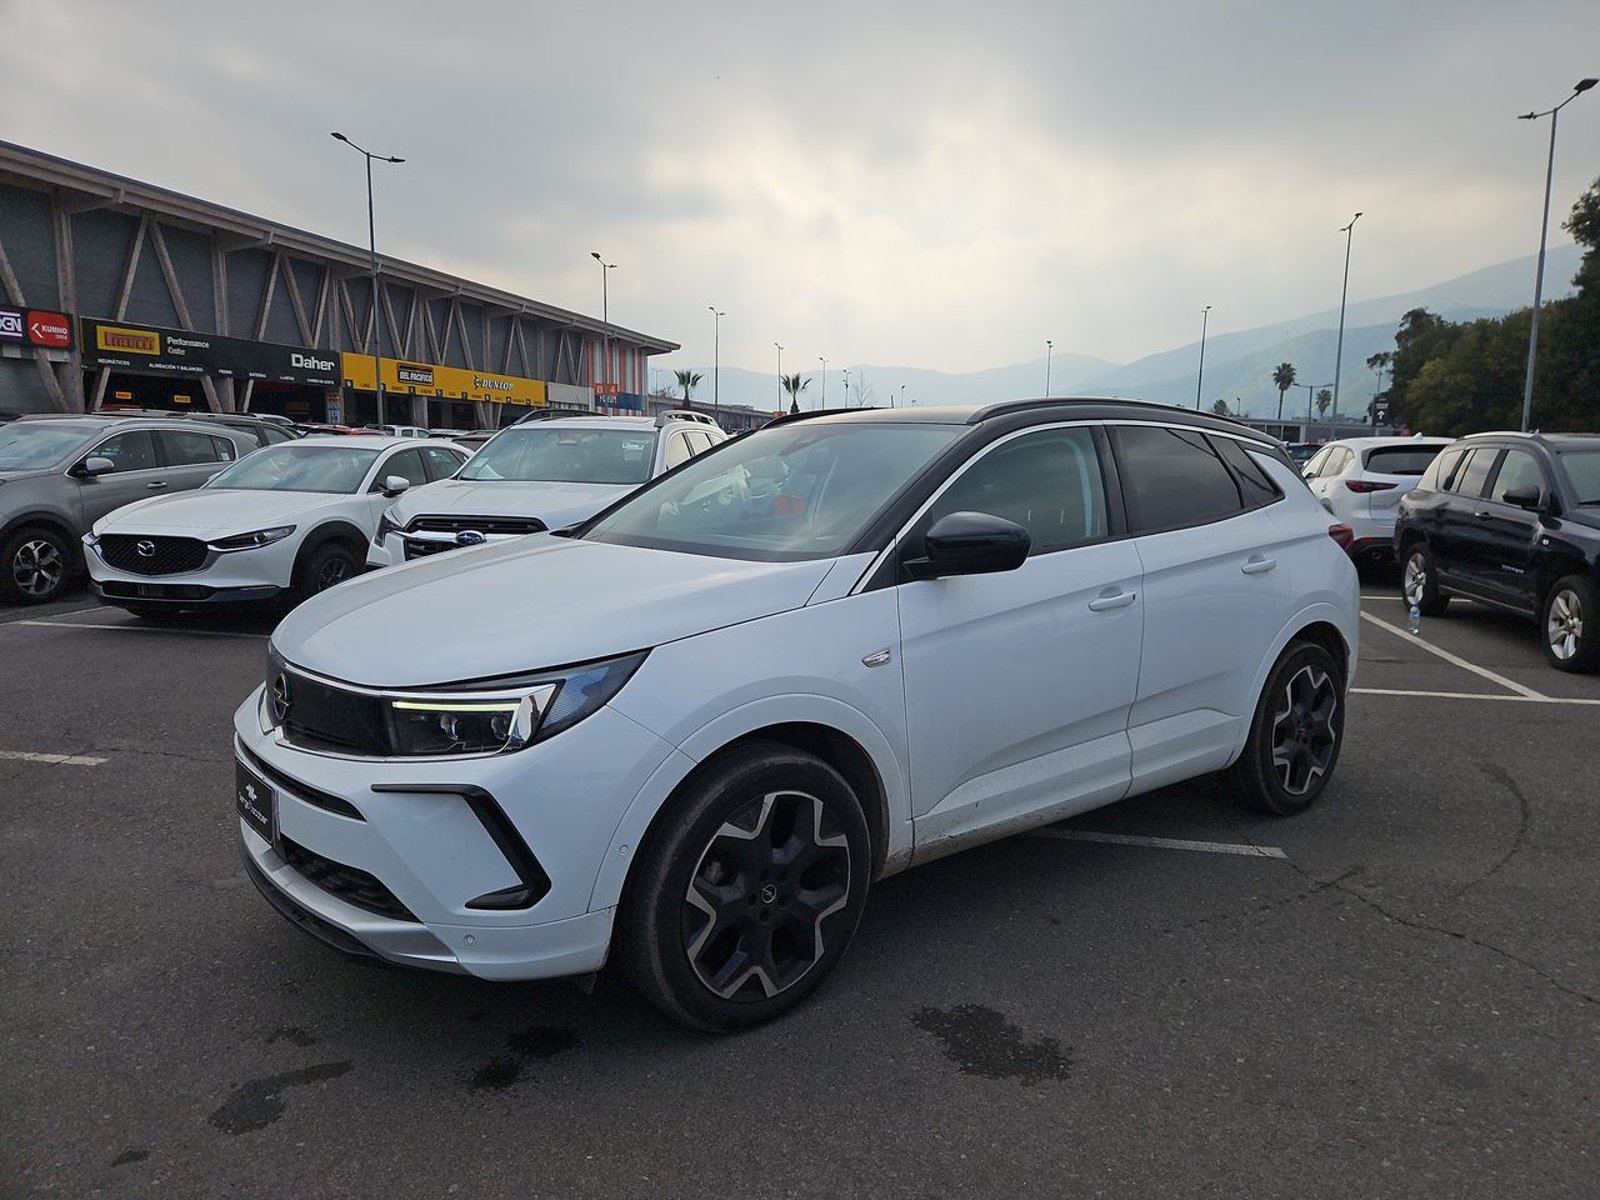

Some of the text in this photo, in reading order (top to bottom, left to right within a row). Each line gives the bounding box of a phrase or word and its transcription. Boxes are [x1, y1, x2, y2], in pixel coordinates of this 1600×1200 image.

[41, 325, 68, 335] KUMHO
[105, 331, 155, 351] PIRELLI
[167, 336, 209, 349] Performance
[291, 353, 335, 371] Daher
[400, 371, 410, 380] DEL
[481, 379, 514, 391] DUNLOP
